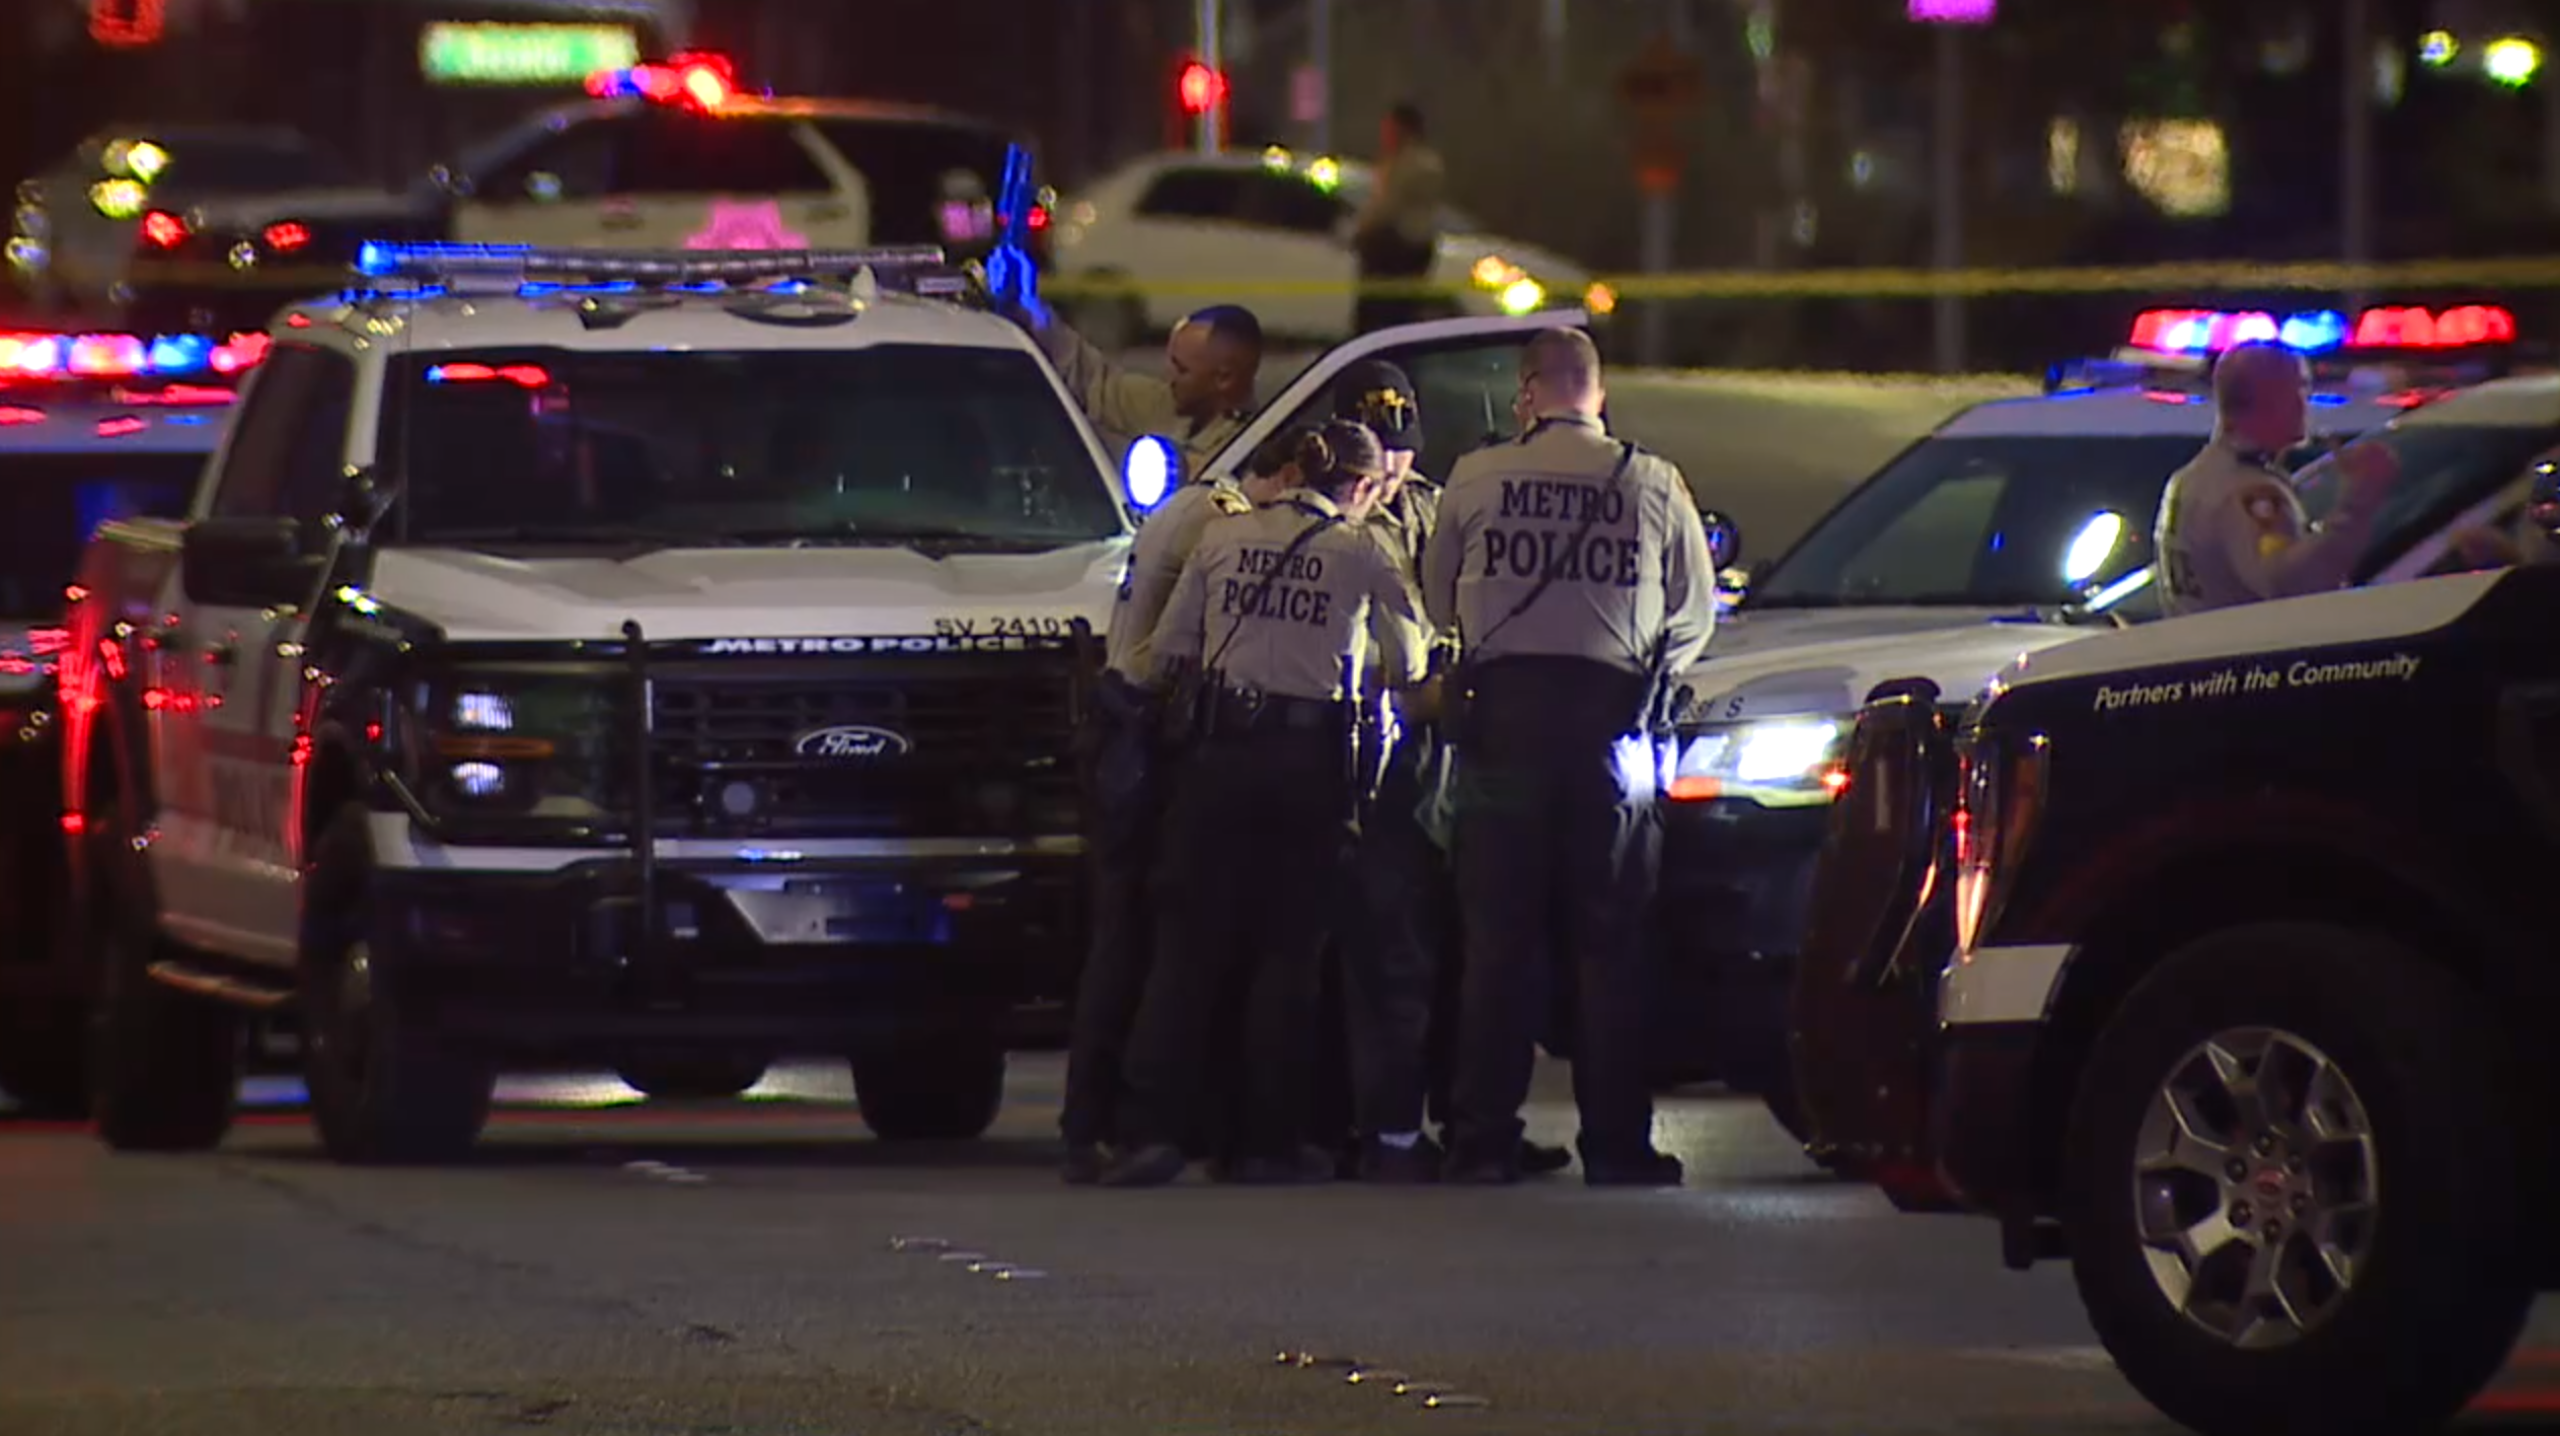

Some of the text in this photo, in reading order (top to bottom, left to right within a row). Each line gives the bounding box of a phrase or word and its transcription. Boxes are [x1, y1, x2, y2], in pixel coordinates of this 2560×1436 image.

[1500, 479, 1625, 525] METRO
[1237, 548, 1323, 582] METRO
[1484, 528, 1639, 587] POLICE
[1222, 578, 1331, 626] POLICE
[703, 638, 1026, 653] METRO POLICE
[2094, 652, 2423, 711] Partners with the Community
